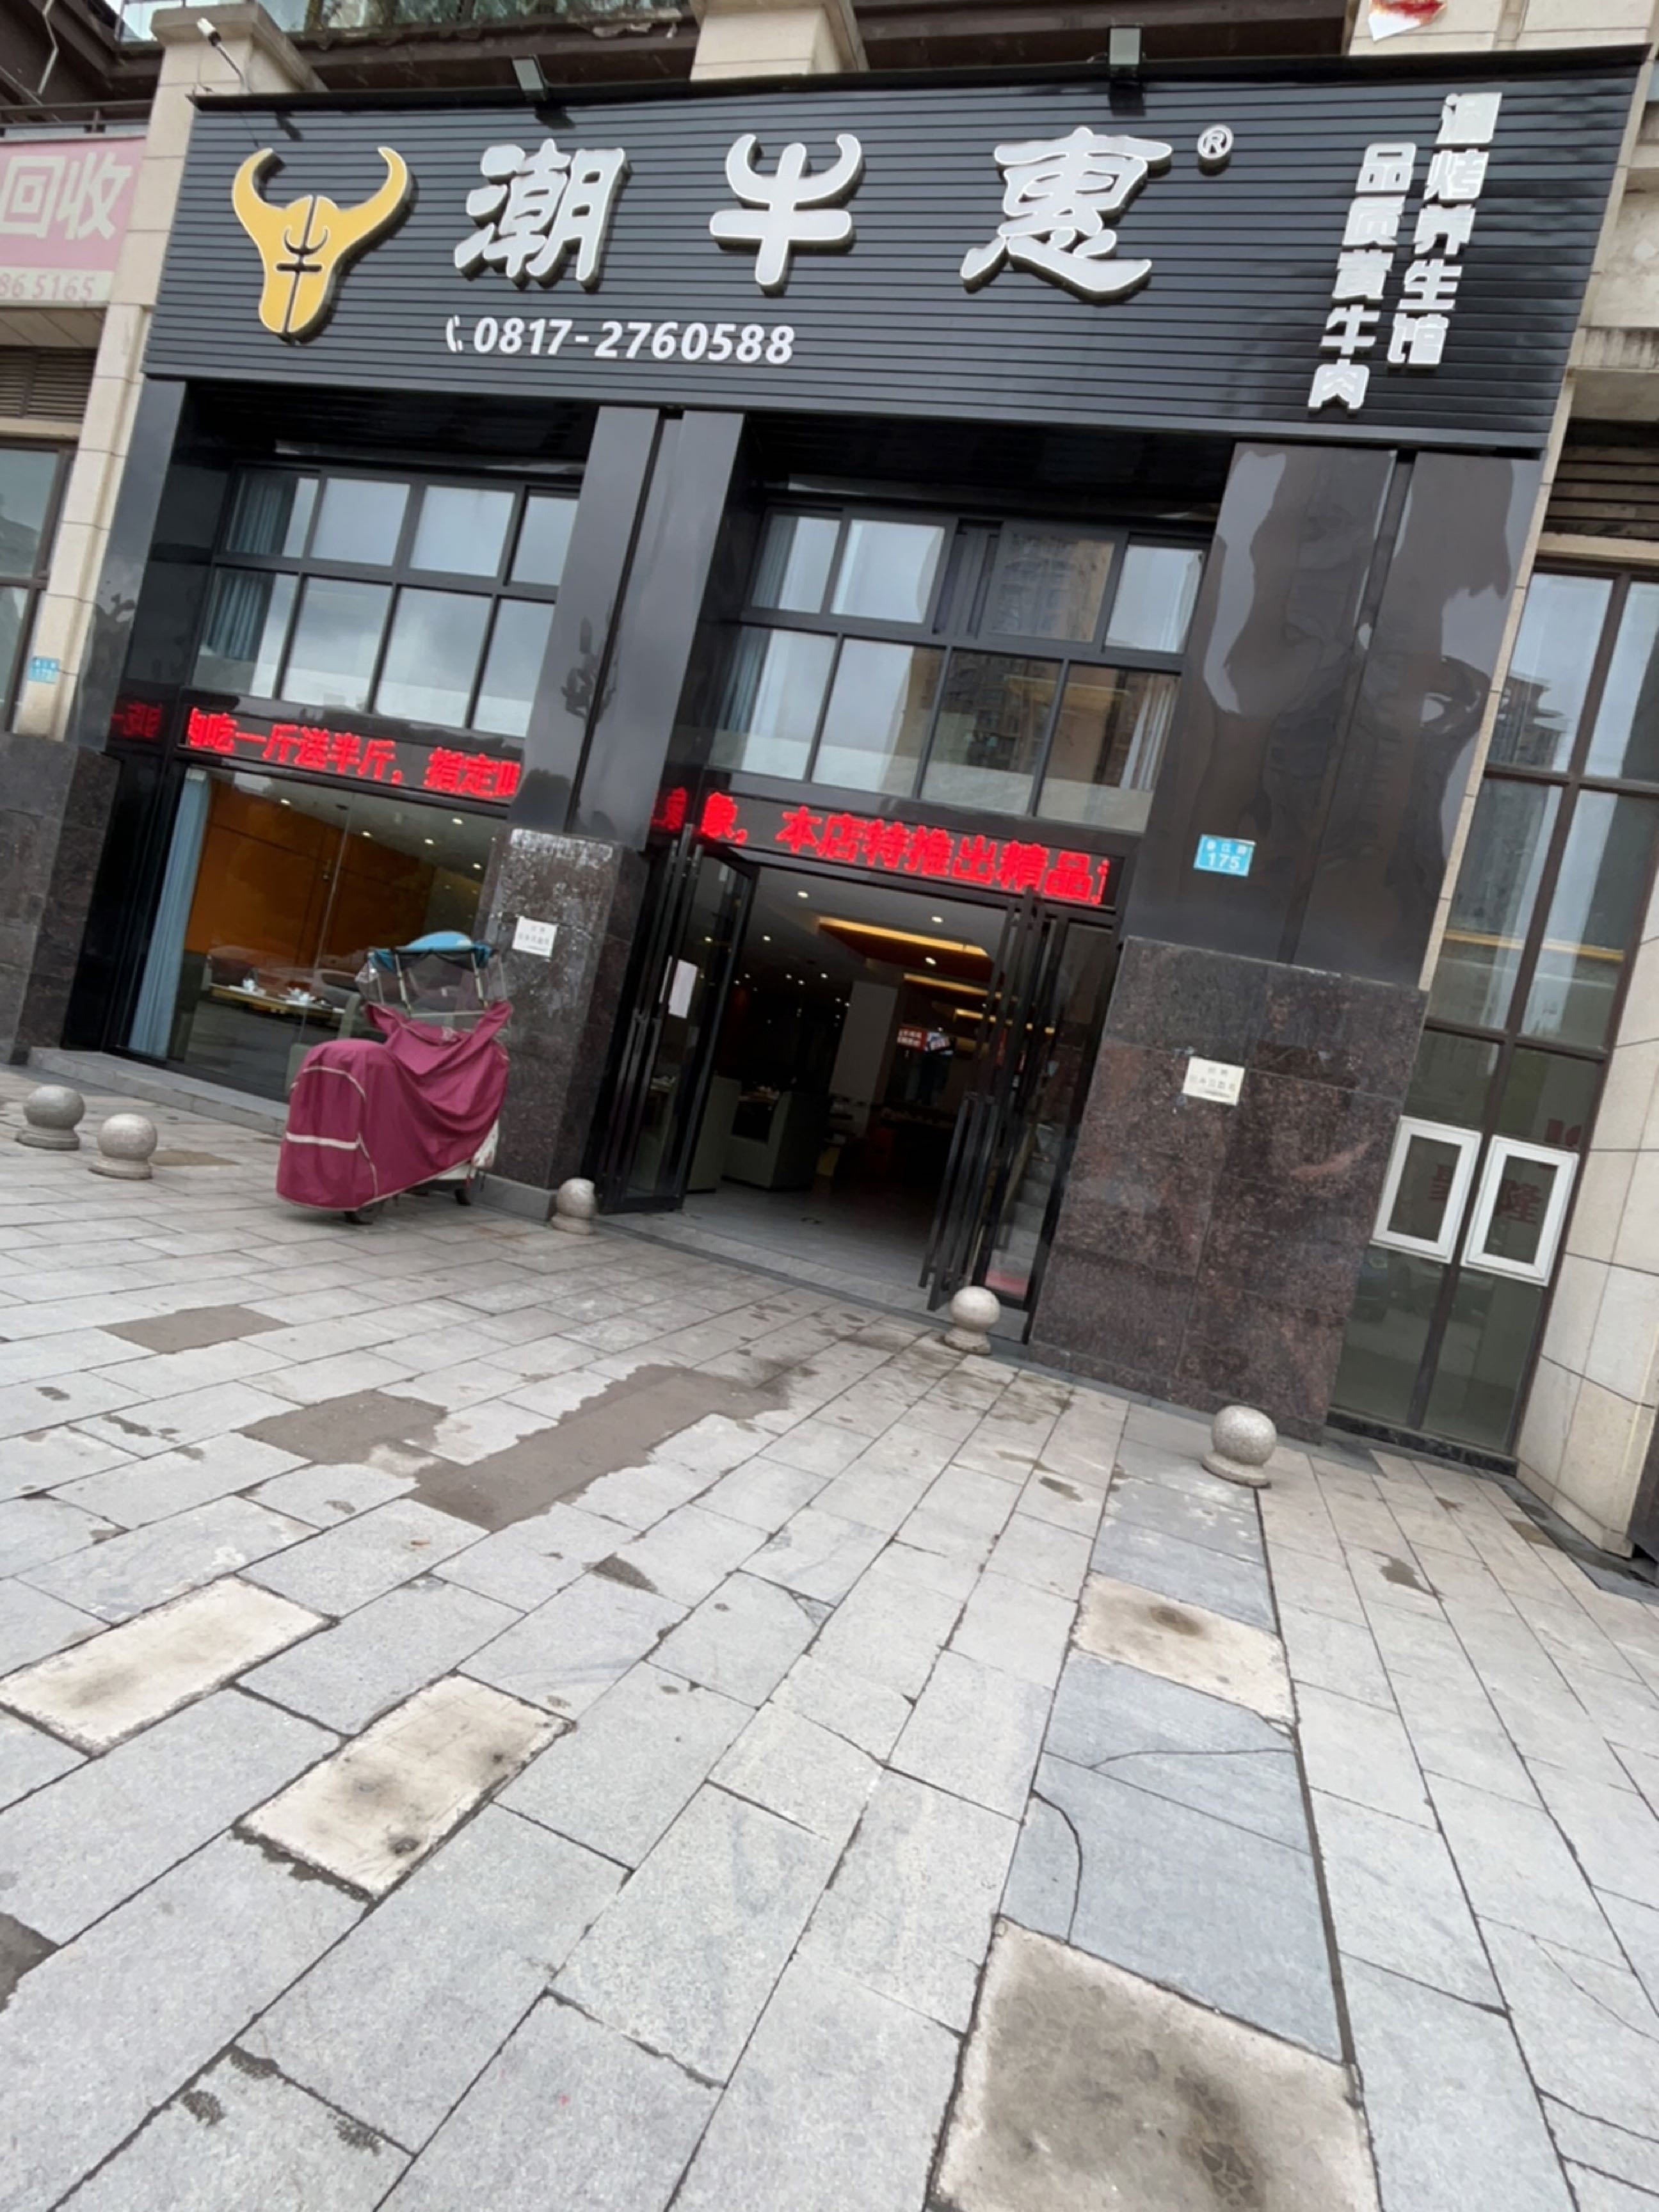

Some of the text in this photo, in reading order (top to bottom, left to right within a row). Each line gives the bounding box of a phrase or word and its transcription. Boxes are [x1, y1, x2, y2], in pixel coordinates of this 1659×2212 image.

[0, 151, 132, 241] 回收
[454, 126, 1173, 292] 潮牛惠
[1308, 142, 1417, 411] 品质黄牛肉
[474, 317, 796, 365] 0817-2760588
[1208, 852, 1240, 871] 175
